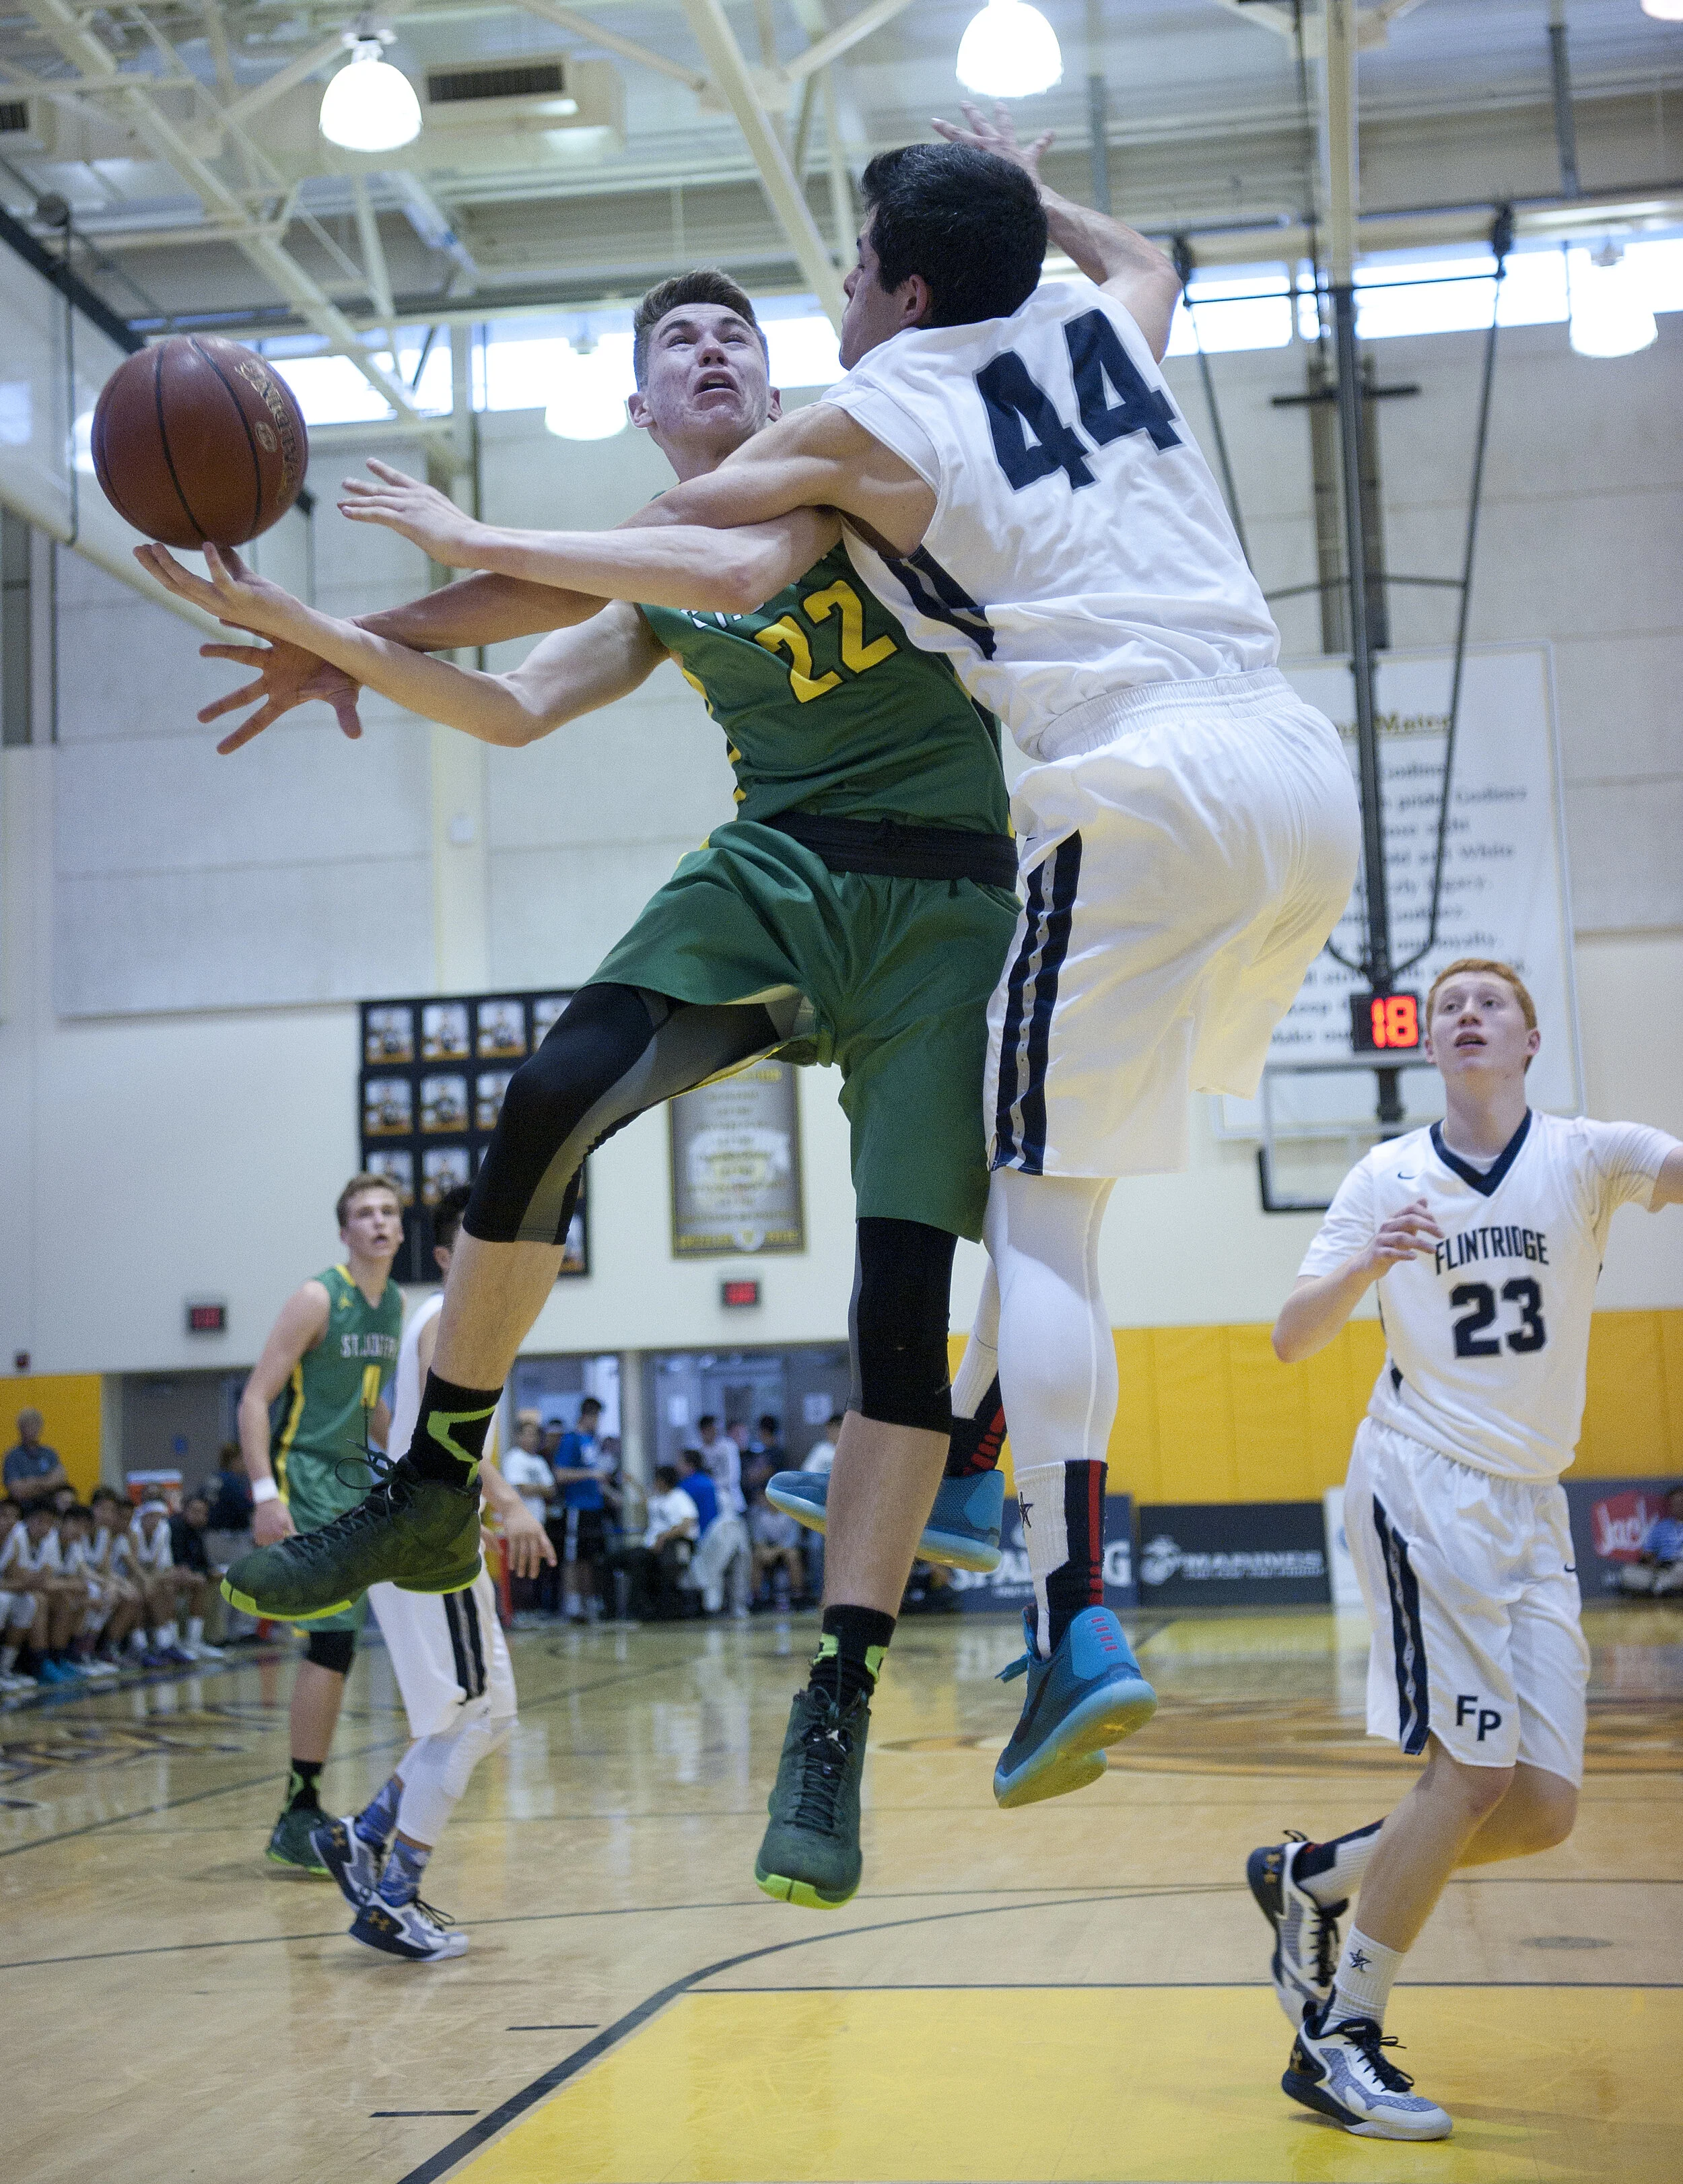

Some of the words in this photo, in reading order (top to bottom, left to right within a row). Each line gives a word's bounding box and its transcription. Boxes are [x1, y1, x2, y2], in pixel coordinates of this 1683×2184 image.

[973, 306, 1183, 494] 44
[754, 580, 899, 704] 22
[1371, 996, 1418, 1048] 18
[1435, 1225, 1549, 1275] FLINTRIDGE
[1449, 1276, 1546, 1359] 23
